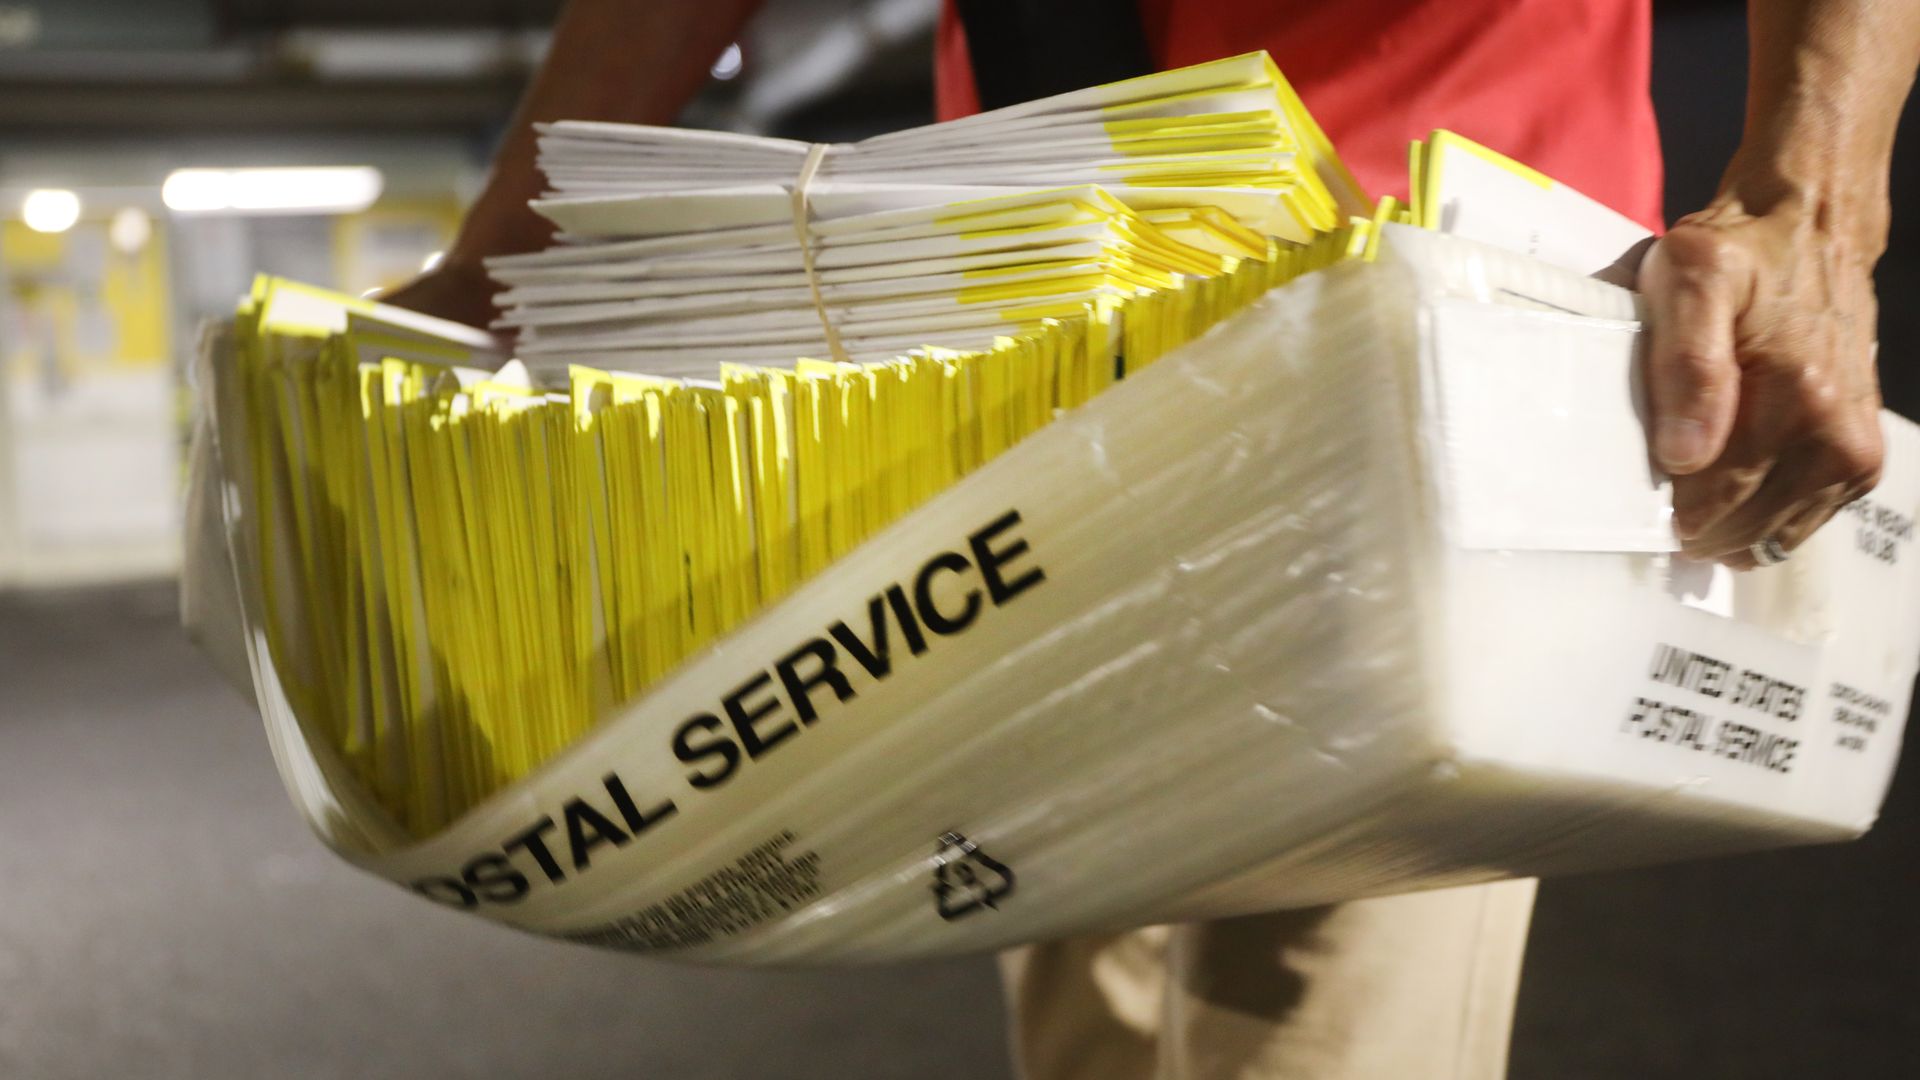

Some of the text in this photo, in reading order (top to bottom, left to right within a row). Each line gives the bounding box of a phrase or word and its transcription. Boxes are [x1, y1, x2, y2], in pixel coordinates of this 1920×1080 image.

[672, 509, 1046, 790] SERVICE
[1650, 642, 1732, 698] UNITED
[1731, 669, 1807, 721] STATES
[1620, 697, 1800, 773] POSTAL SERVICE
